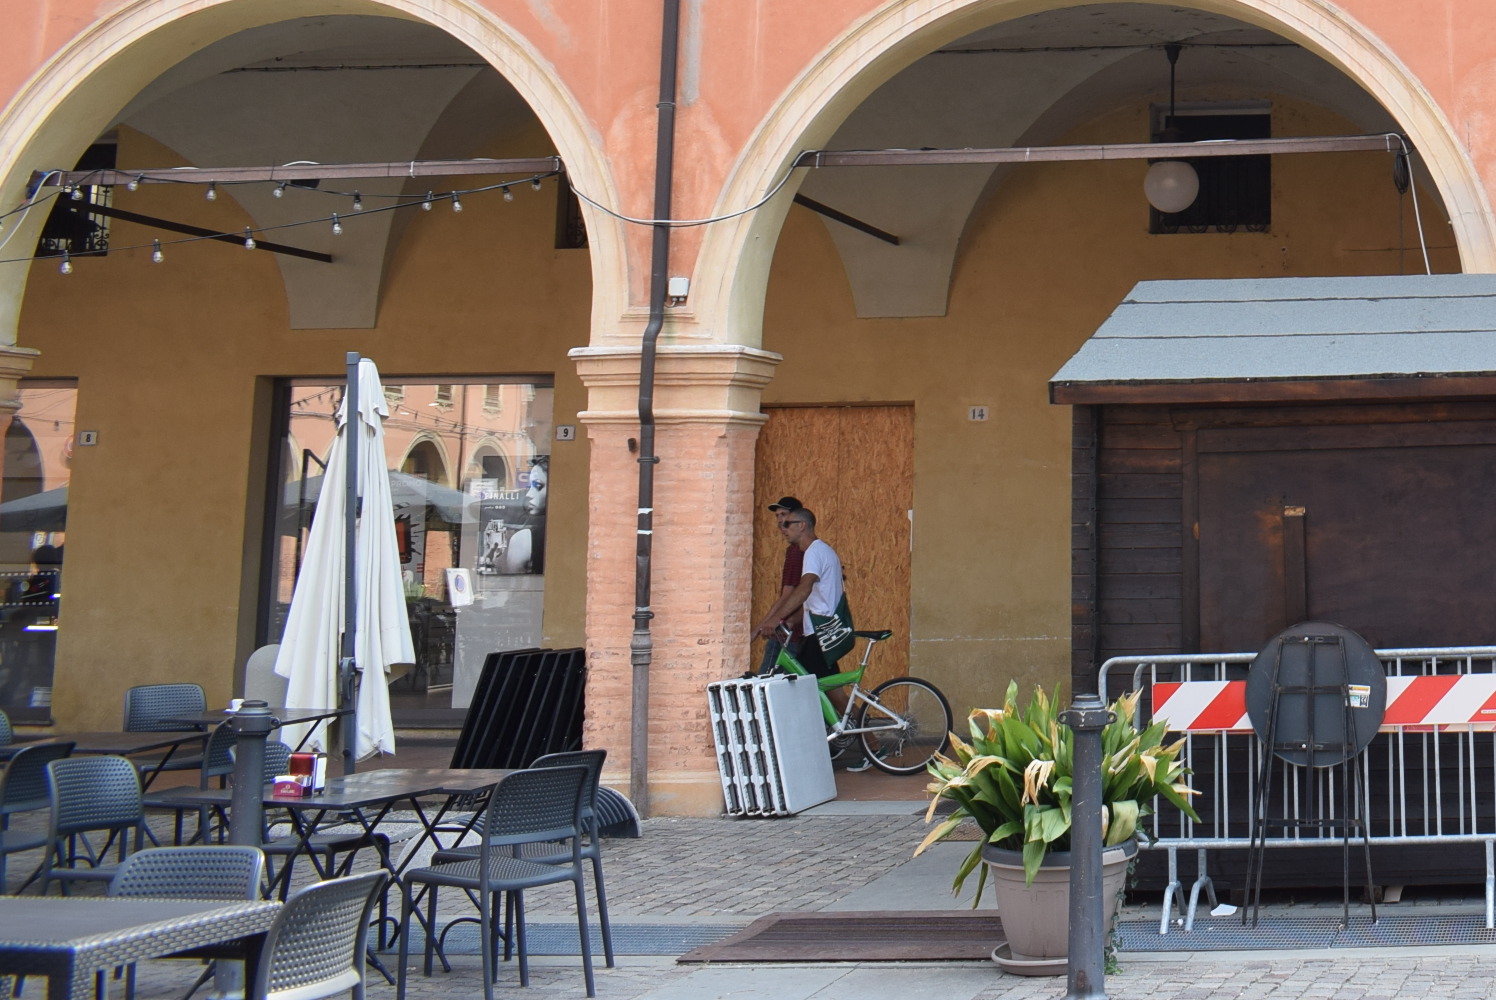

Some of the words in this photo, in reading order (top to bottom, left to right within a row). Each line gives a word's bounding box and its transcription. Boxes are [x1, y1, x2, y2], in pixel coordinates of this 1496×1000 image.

[972, 408, 984, 420] 14
[86, 433, 91, 443] 8
[563, 427, 569, 438] 9
